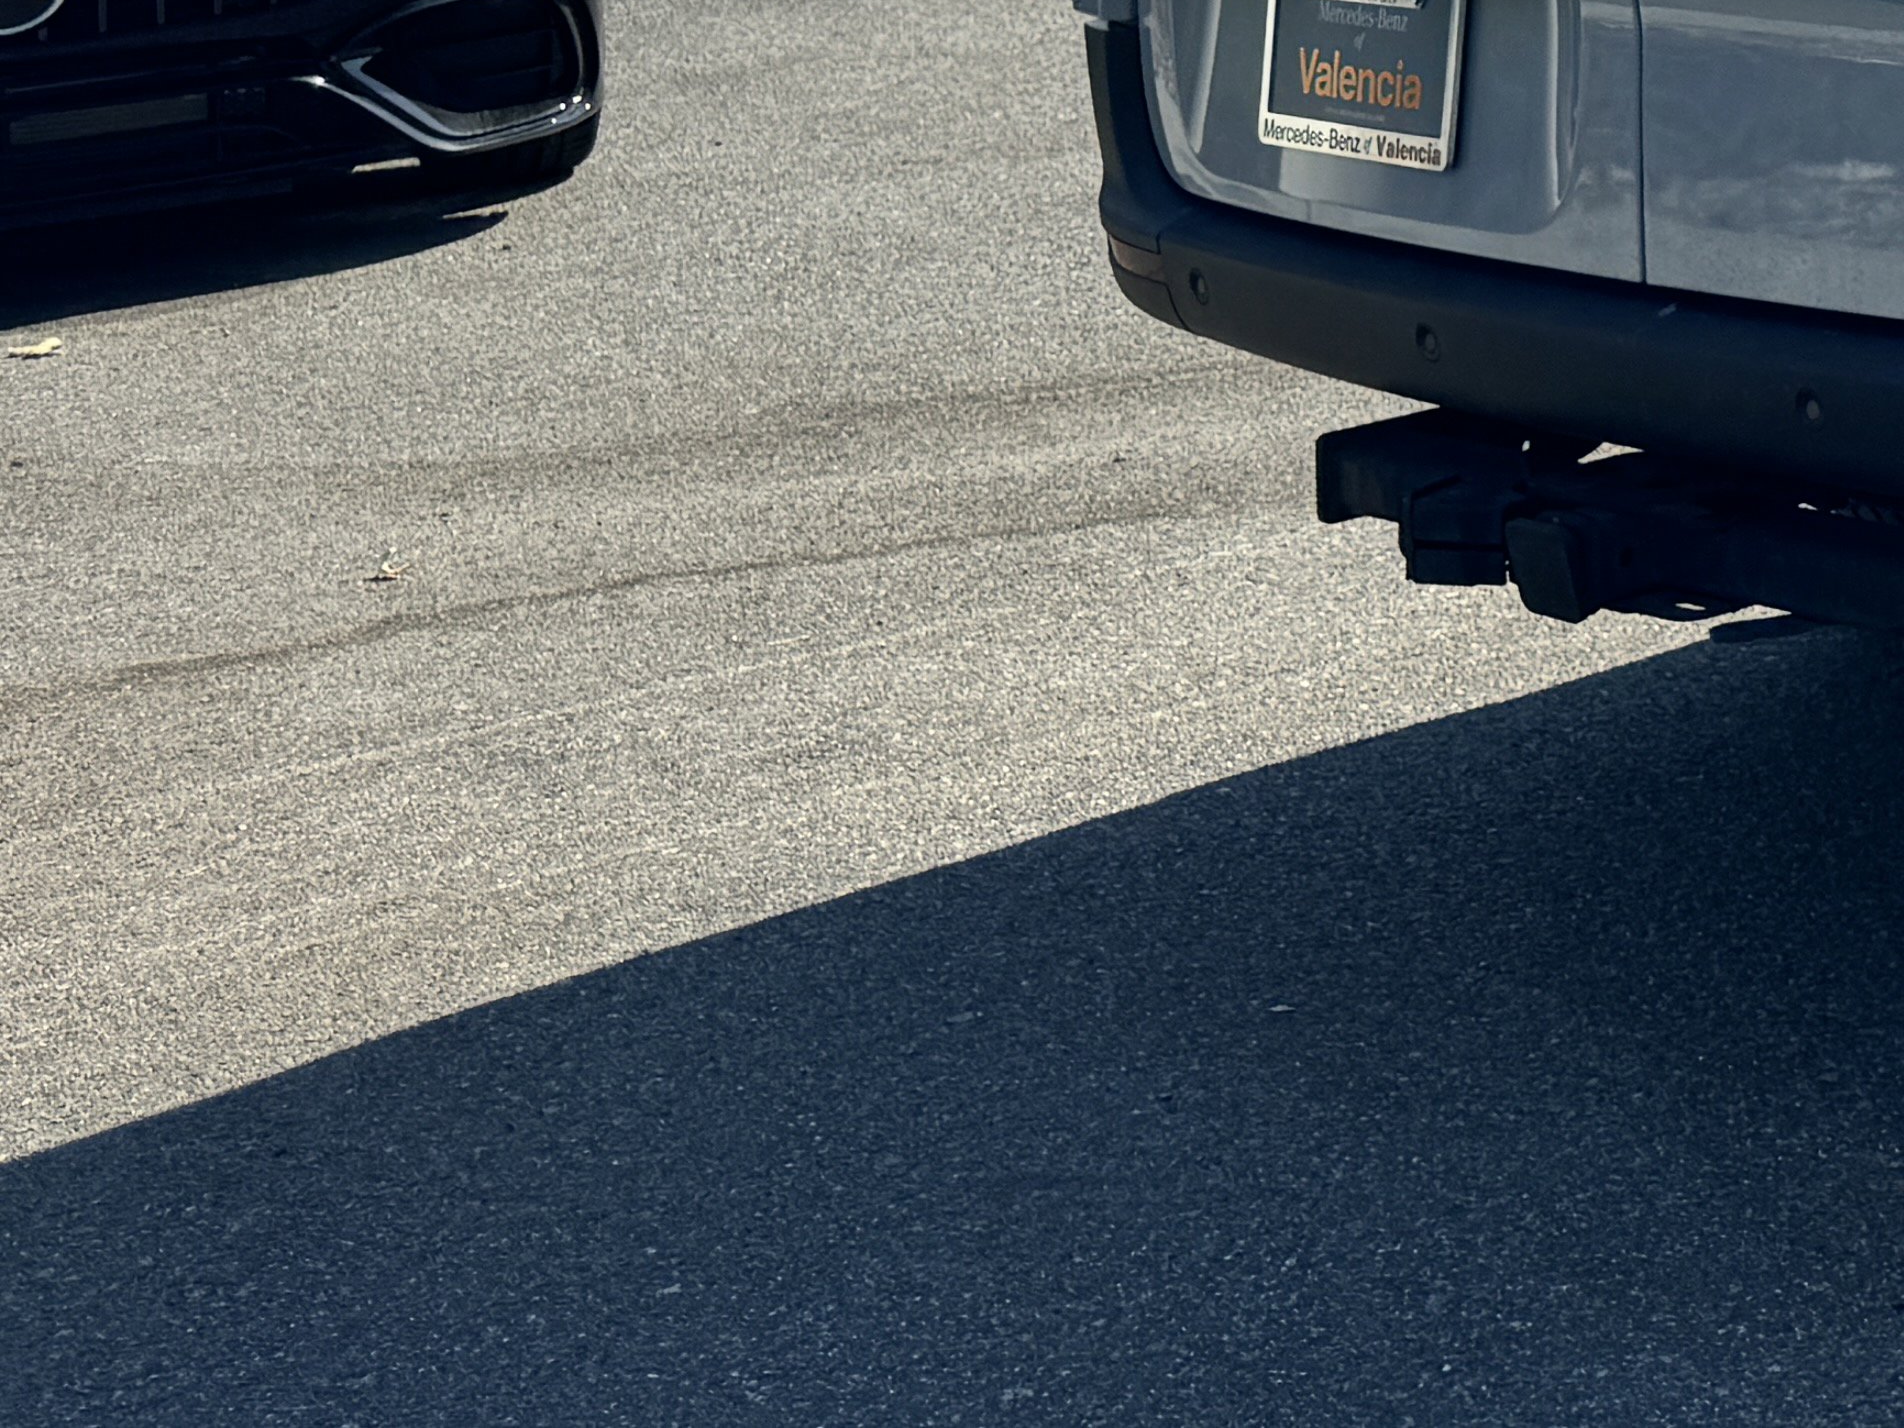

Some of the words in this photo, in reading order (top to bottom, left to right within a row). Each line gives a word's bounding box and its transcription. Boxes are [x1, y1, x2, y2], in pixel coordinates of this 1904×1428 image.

[1319, 0, 1409, 33] Mercedes-Benz
[1300, 47, 1423, 110] Valencia
[1263, 118, 1361, 154] Mercedes-Benz
[1376, 135, 1442, 166] Valencia
